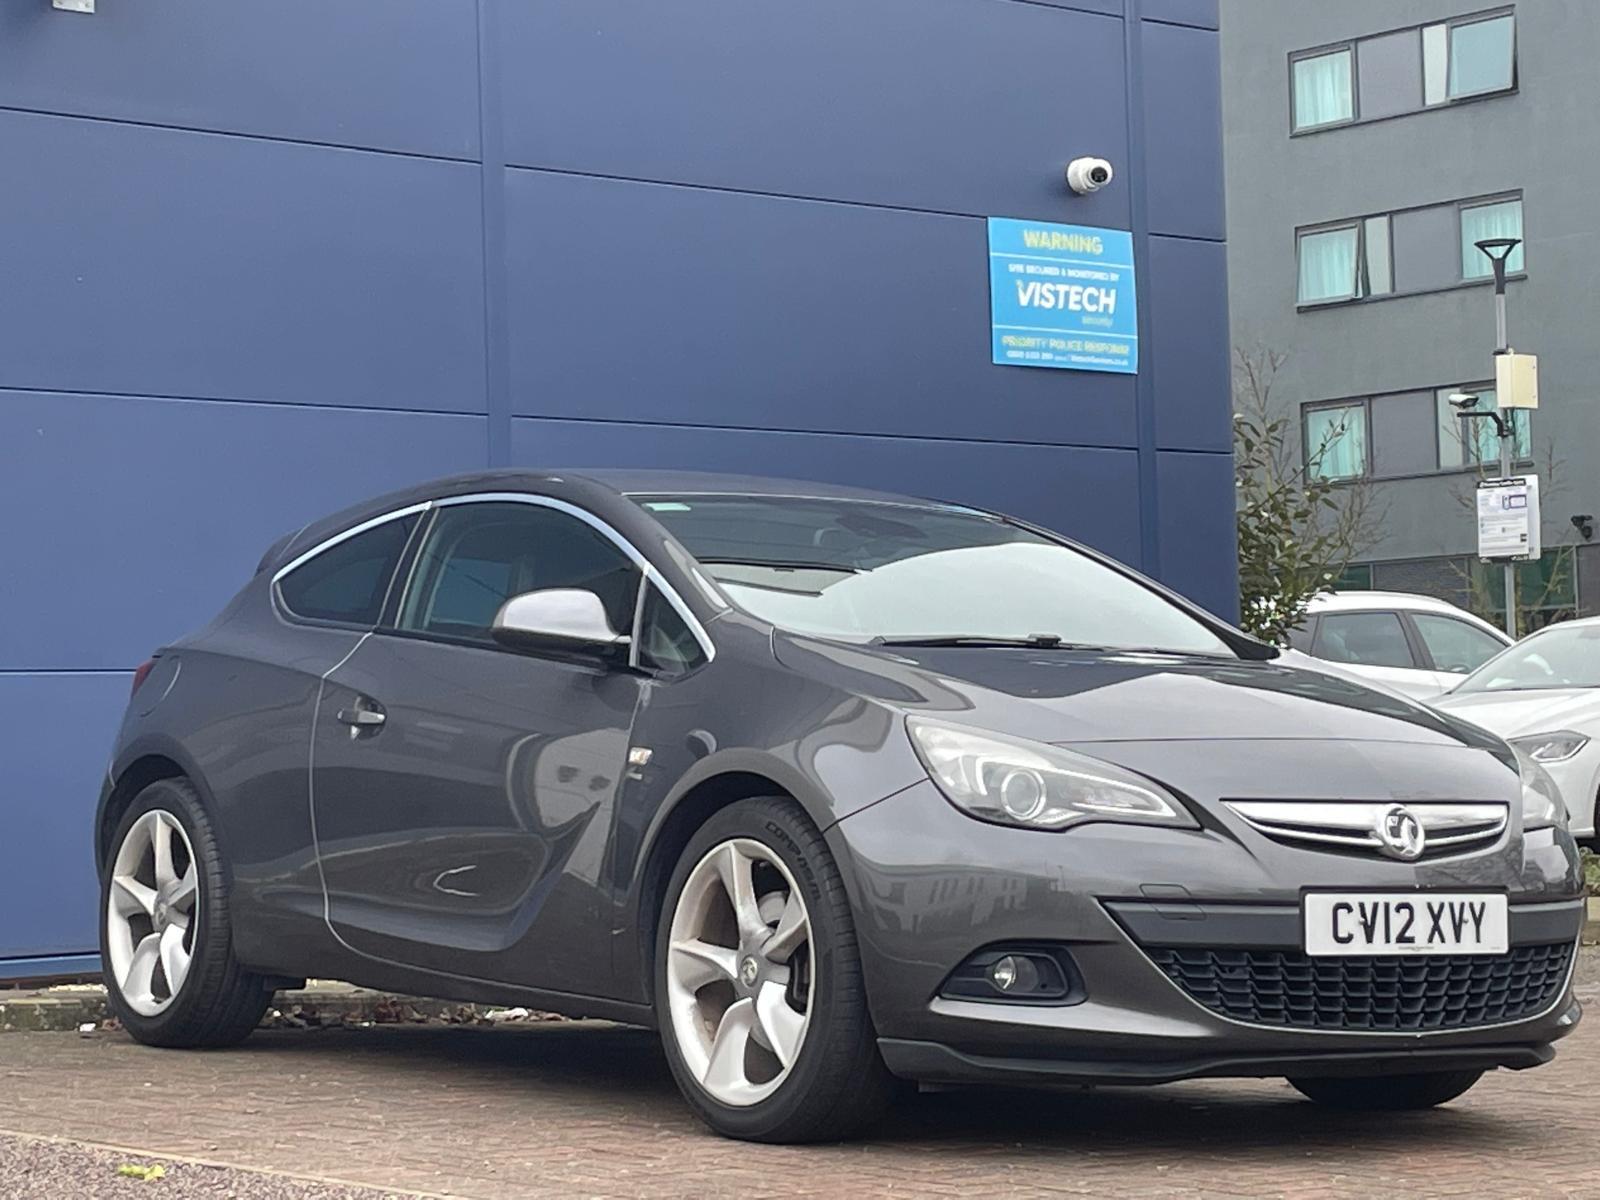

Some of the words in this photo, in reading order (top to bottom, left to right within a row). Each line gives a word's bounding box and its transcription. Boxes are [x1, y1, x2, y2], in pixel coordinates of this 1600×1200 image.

[1023, 229, 1103, 255] WARNING
[1016, 279, 1117, 315] VISTECH
[1332, 902, 1416, 944] CV12
[1427, 902, 1486, 944] XVY
